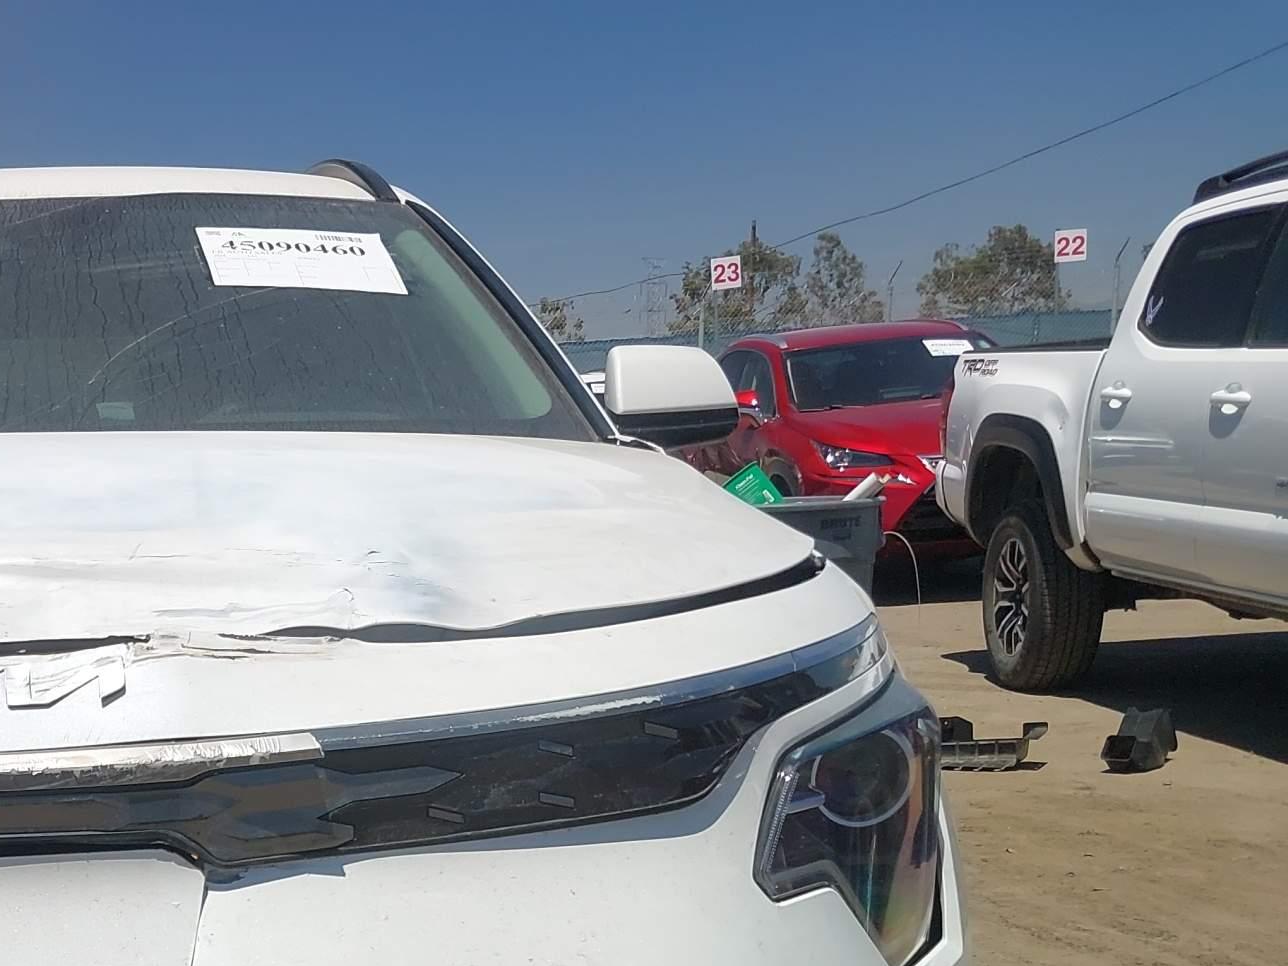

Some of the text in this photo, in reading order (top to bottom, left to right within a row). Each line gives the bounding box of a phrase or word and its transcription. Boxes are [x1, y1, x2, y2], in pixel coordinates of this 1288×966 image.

[221, 240, 366, 256] 45090460
[1057, 236, 1085, 257] 22
[713, 262, 740, 284] 23
[962, 359, 985, 376] TRD
